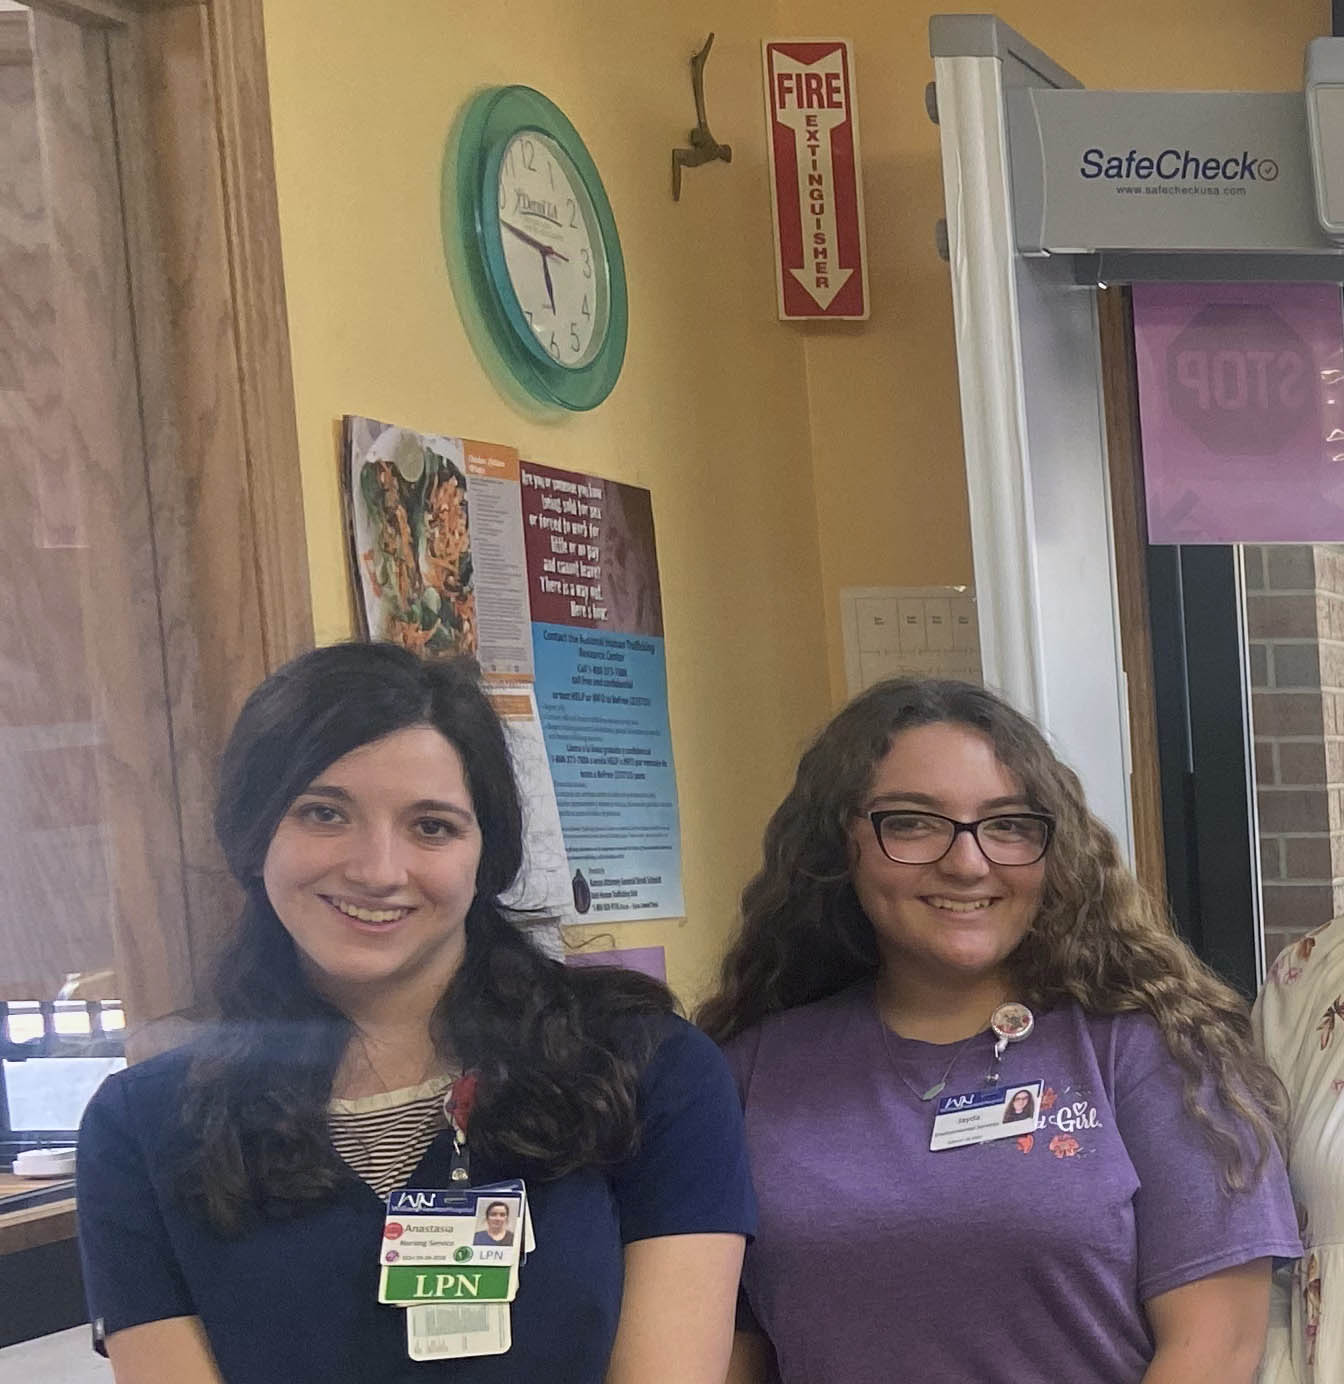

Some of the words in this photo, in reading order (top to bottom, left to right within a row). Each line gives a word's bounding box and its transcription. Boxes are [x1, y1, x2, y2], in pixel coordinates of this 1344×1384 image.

[777, 73, 843, 110] FIRE
[520, 139, 537, 172] 12
[1080, 149, 1258, 181] SafeCheck
[805, 114, 829, 288] EXTINGUISHER
[1116, 185, 1247, 196] www.safecheckusa.com
[566, 199, 578, 229] 2
[580, 248, 592, 279] 3
[581, 295, 591, 321] 4
[570, 323, 581, 352] 5
[405, 1224, 454, 1233] Anastasia
[480, 1250, 504, 1260] LPN
[413, 1274, 482, 1298] LPN
